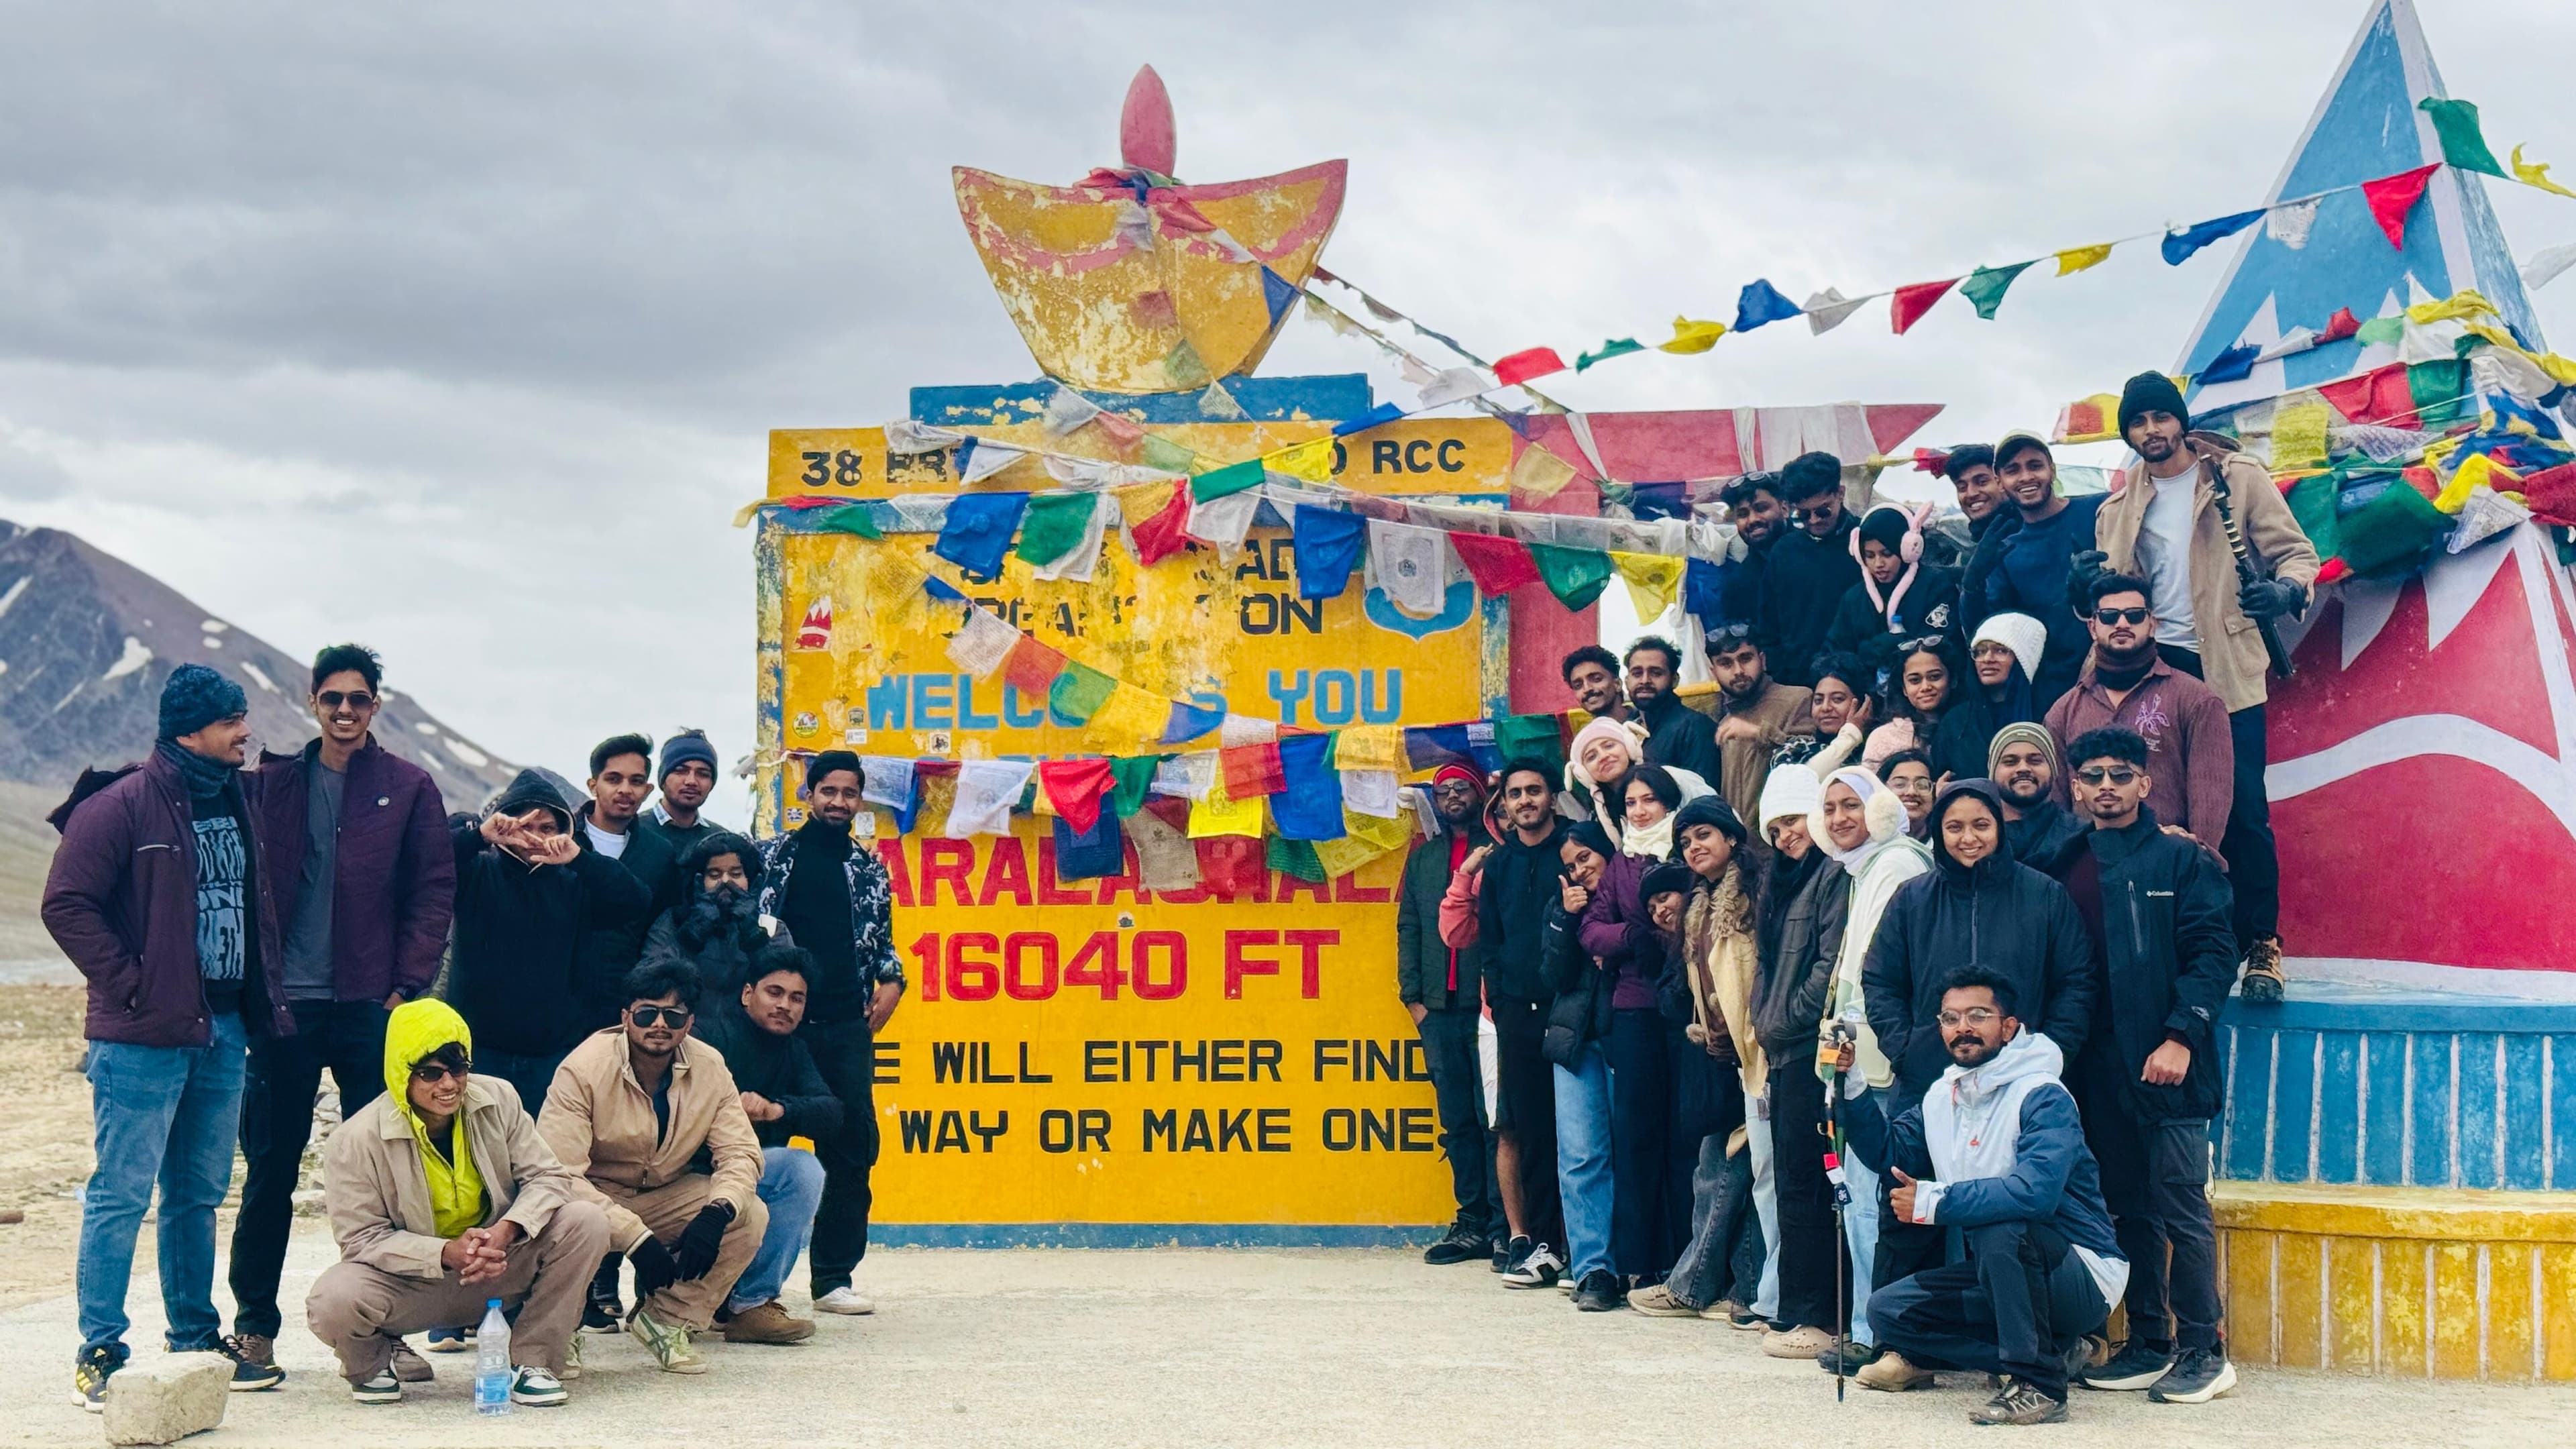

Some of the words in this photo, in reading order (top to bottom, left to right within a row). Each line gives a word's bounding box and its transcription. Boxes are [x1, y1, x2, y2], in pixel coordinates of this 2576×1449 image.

[802, 449, 862, 486] 38
[1373, 439, 1466, 474] RCC
[1268, 669, 1401, 725] YOU
[909, 930, 1187, 1002] 16040
[1225, 930, 1340, 1000] FT
[932, 1041, 1053, 1083] WILL
[1084, 1040, 1283, 1083] EITHER
[899, 1110, 1008, 1153] WAY
[1040, 1110, 1112, 1152] OR
[1142, 1109, 1291, 1152] MAKE
[1322, 1108, 1434, 1152] ONE
